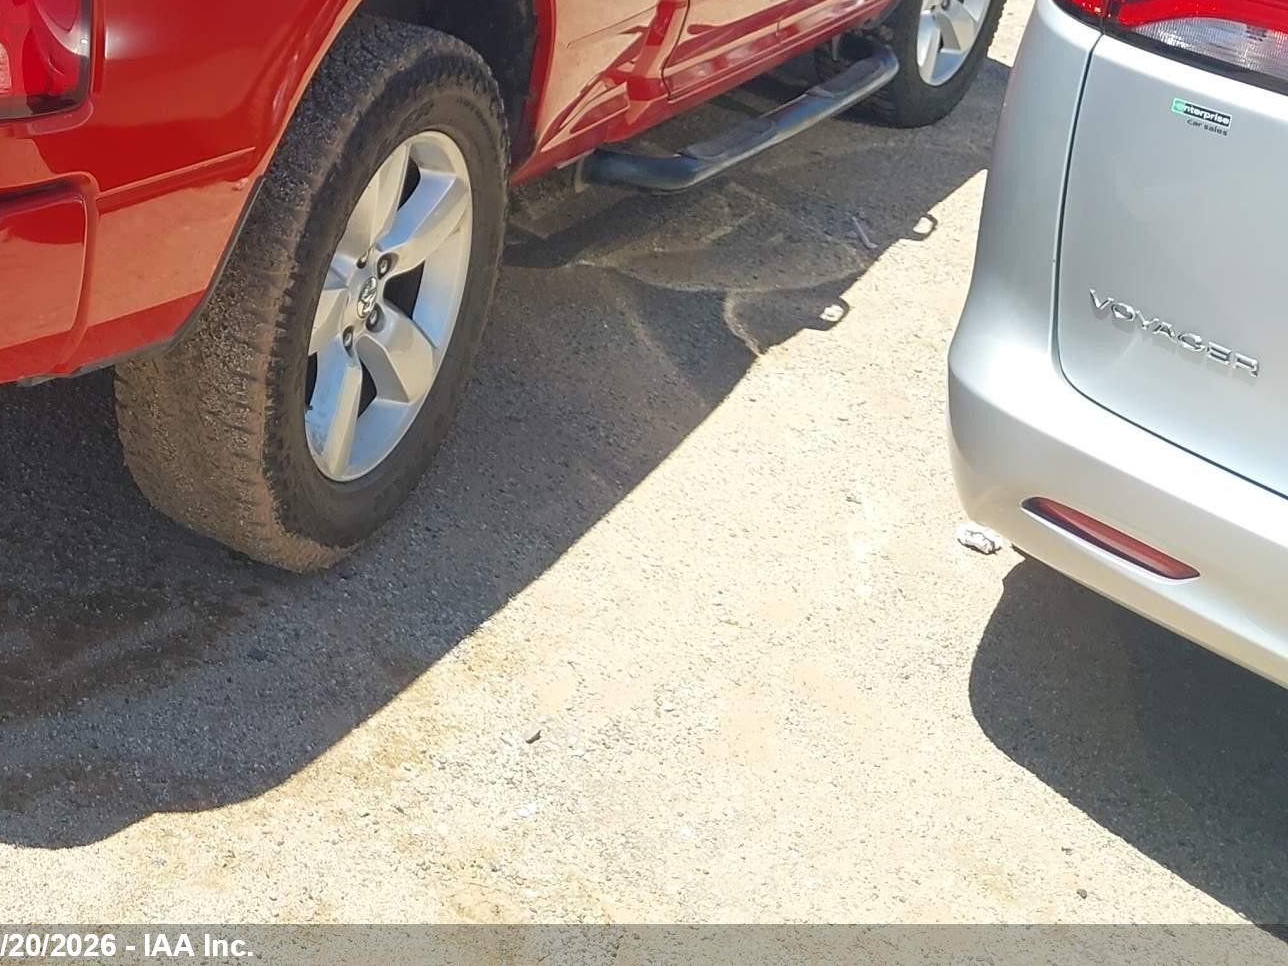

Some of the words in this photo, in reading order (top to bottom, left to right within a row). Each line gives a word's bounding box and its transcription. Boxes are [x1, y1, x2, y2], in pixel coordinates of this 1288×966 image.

[1173, 99, 1231, 125] enterprise
[1186, 119, 1203, 127] car
[1203, 124, 1229, 136] sales
[1089, 288, 1260, 377] VOYAGER
